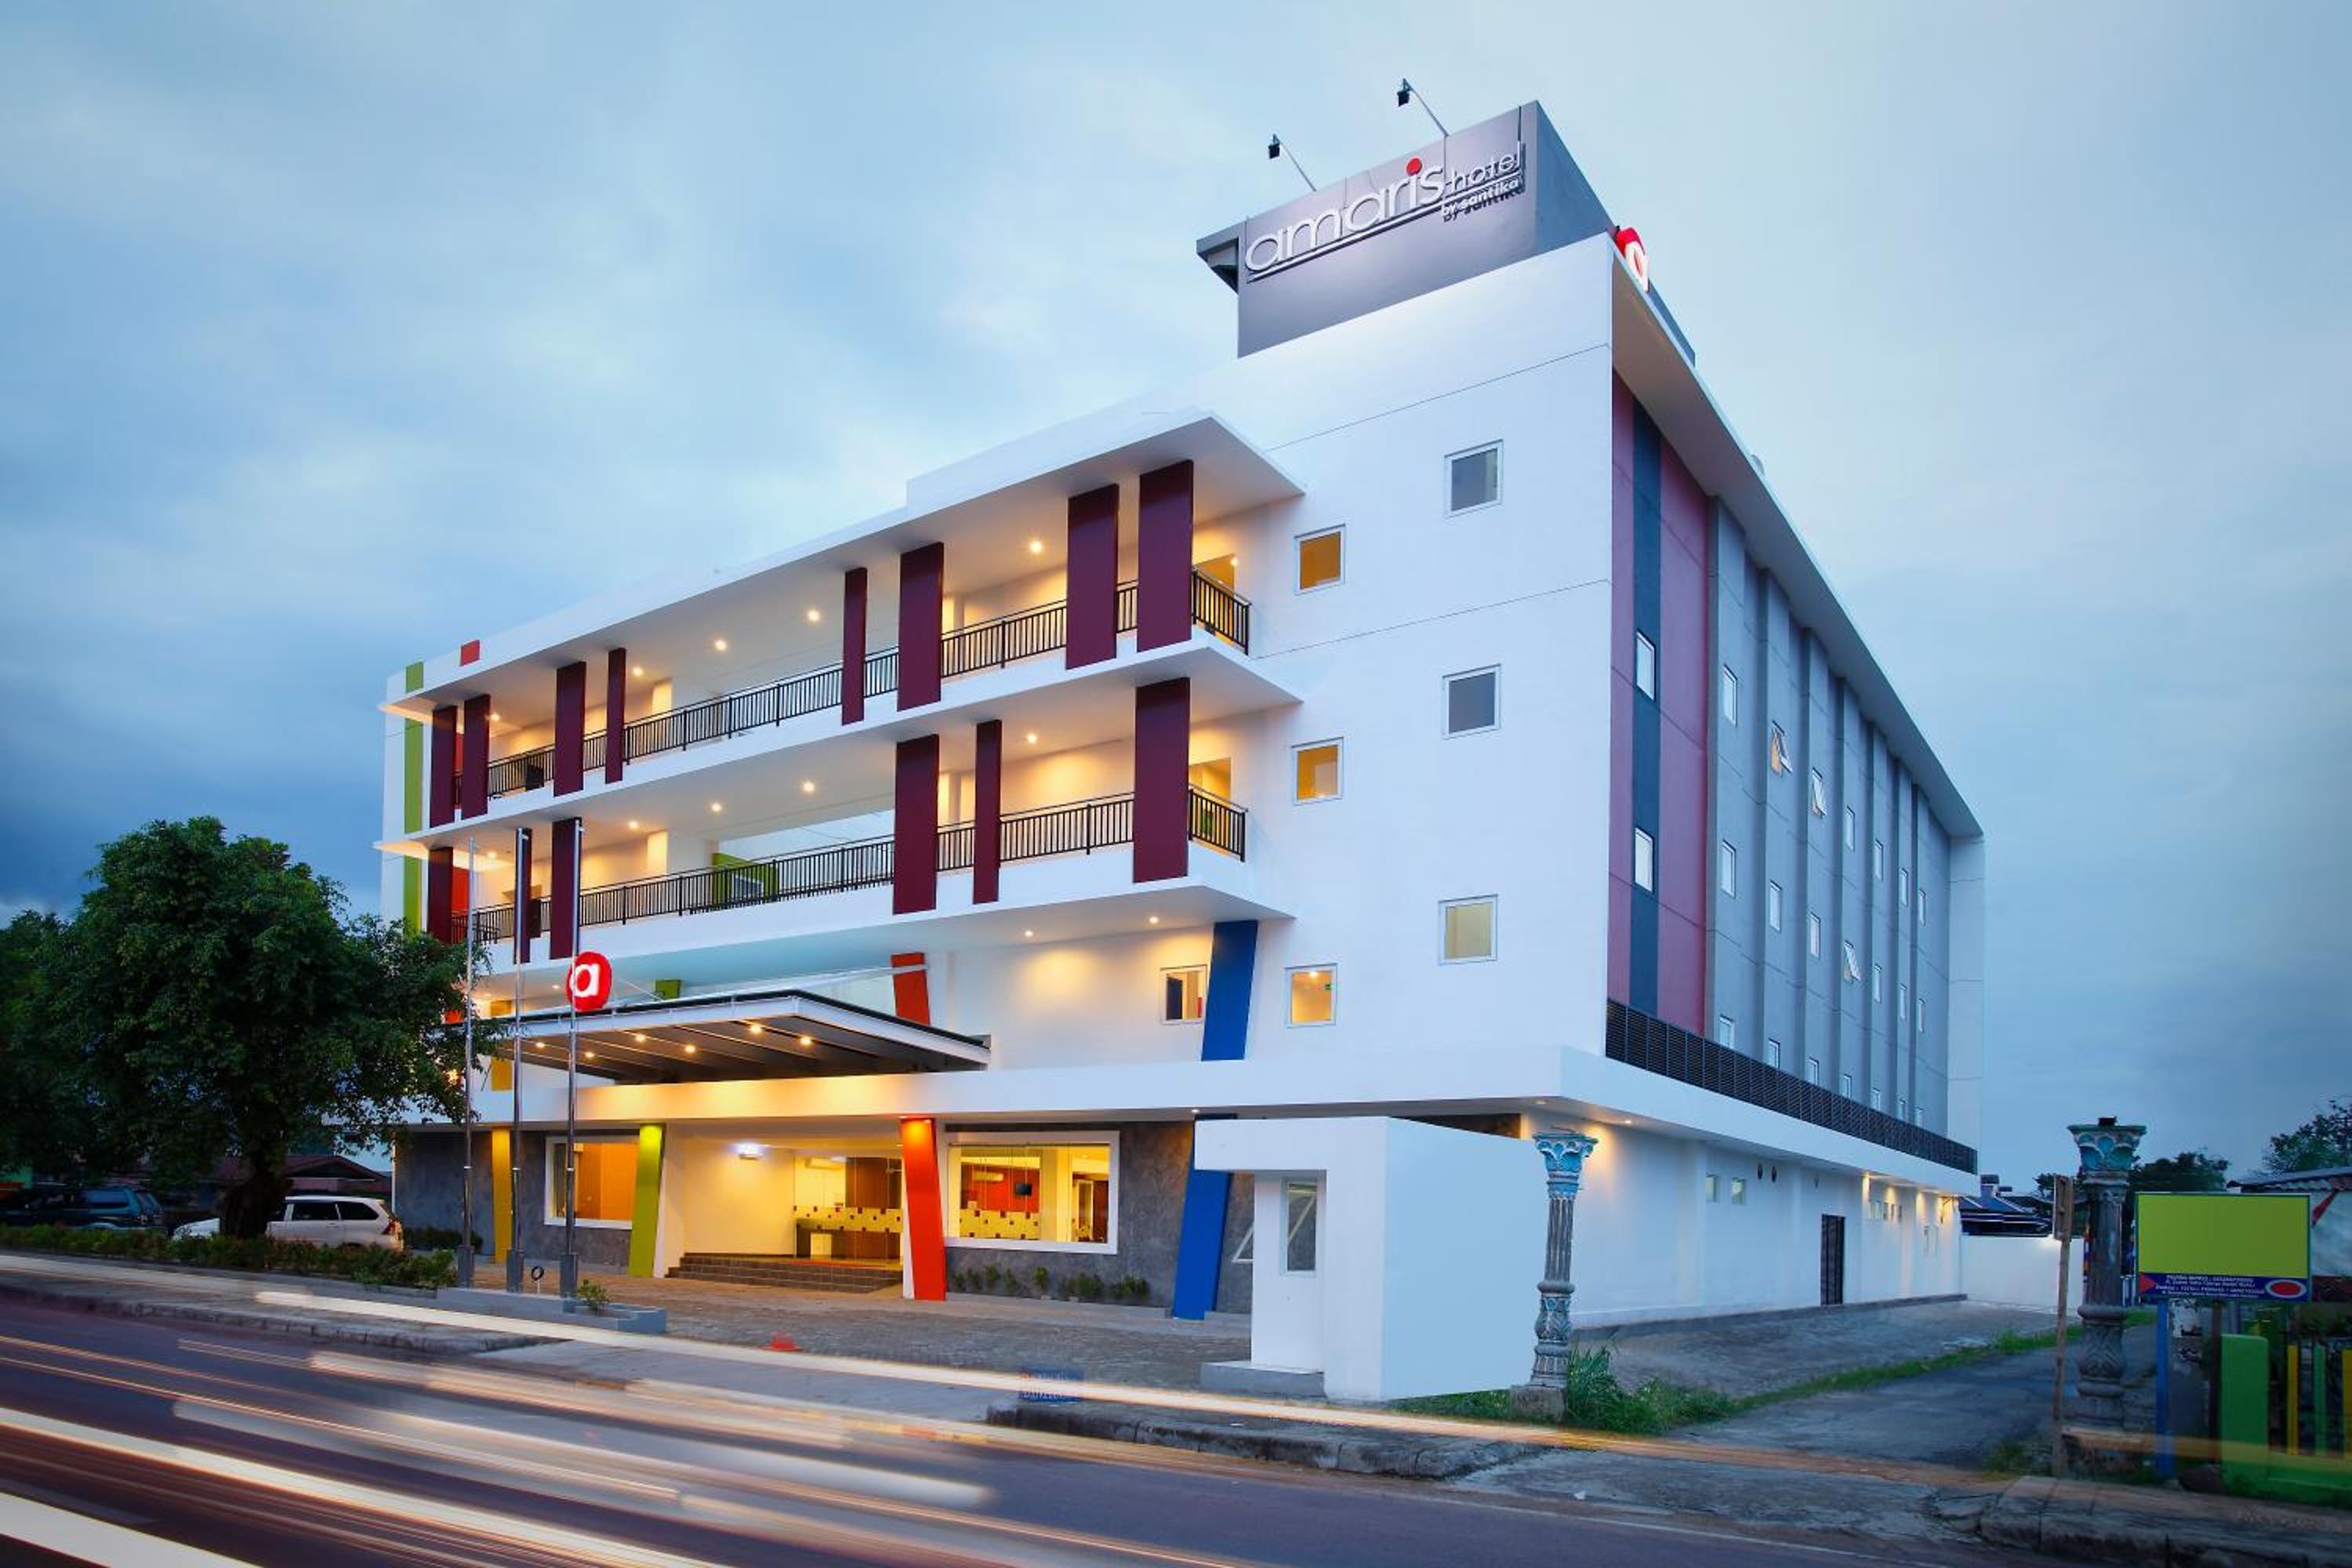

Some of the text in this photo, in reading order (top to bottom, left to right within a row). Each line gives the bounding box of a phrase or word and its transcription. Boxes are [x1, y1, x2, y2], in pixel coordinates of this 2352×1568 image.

[1245, 140, 1520, 271] amaris hotel
[1461, 179, 1519, 209] santika
[569, 963, 601, 998] a
